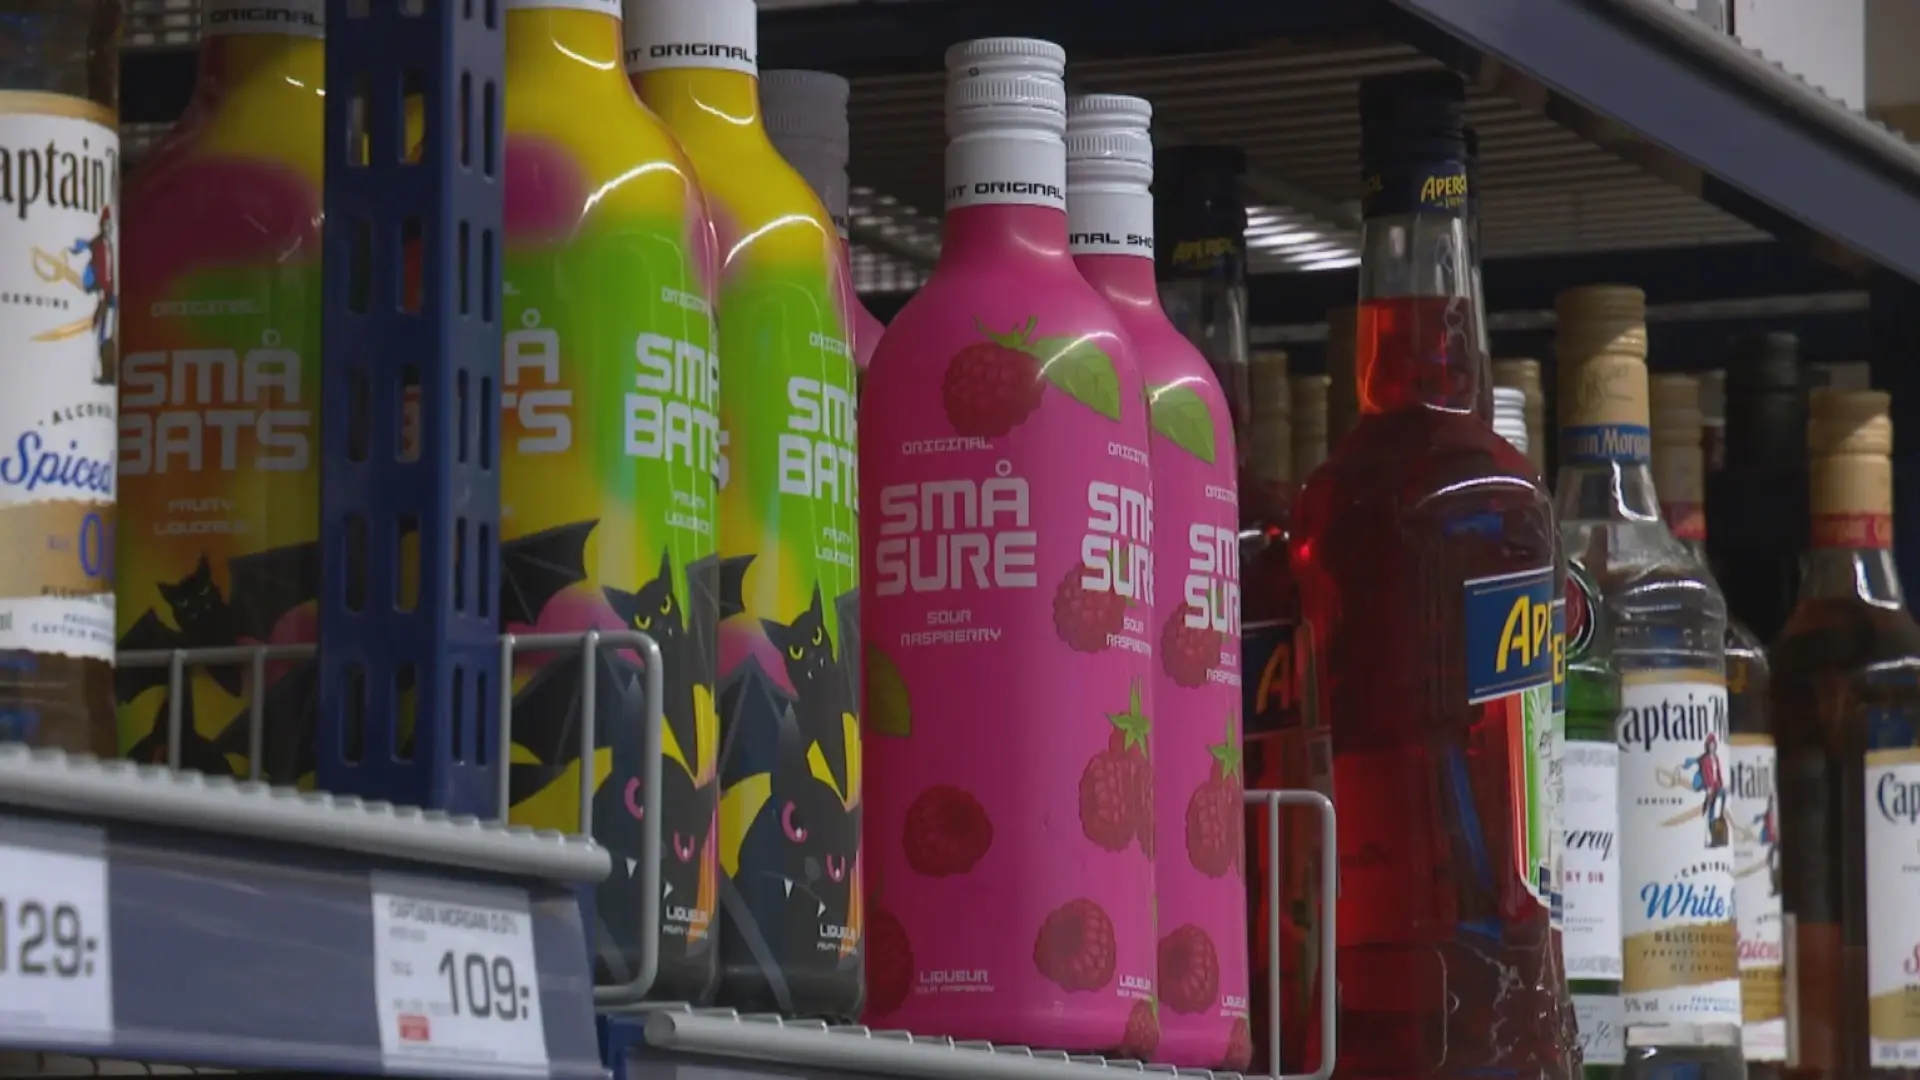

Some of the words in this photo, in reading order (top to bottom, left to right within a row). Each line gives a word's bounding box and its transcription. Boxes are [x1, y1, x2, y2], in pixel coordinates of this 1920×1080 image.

[209, 9, 323, 25] ORIGINAL
[649, 43, 753, 63] ORIGINAL
[974, 181, 1063, 200] ORIGINAL
[120, 328, 300, 408] SMÅ
[902, 436, 993, 455] ORIGINAL
[779, 433, 858, 513] BAT
[879, 460, 1030, 535] SMÅ
[875, 532, 1038, 597] SURE
[926, 610, 972, 626] SOUR
[900, 628, 1002, 647] RASPBERRY
[1641, 881, 1726, 920] White
[438, 948, 530, 1021] 109:
[920, 968, 989, 984] LIQUEUR
